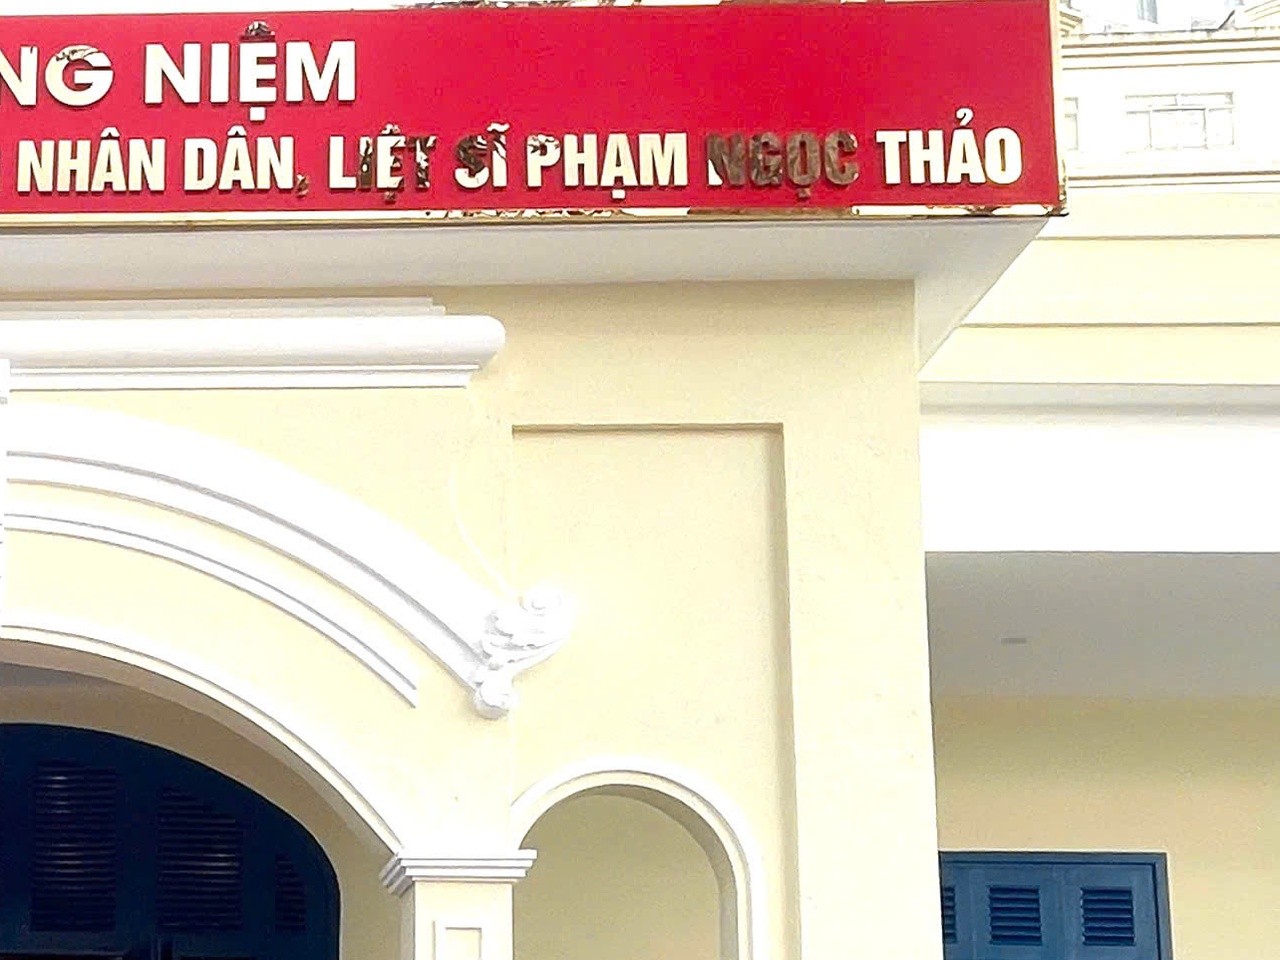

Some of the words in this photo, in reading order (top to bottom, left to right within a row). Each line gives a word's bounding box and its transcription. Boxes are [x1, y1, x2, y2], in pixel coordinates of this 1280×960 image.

[143, 21, 356, 121] NIỆM
[18, 127, 166, 193] NHÂN
[183, 124, 310, 197] DÂN,
[328, 123, 437, 200] LIỆT
[454, 121, 510, 189] SĨ
[526, 131, 688, 200] PHẠM
[706, 130, 859, 200] NGỌC
[875, 107, 1023, 187] THẢO
